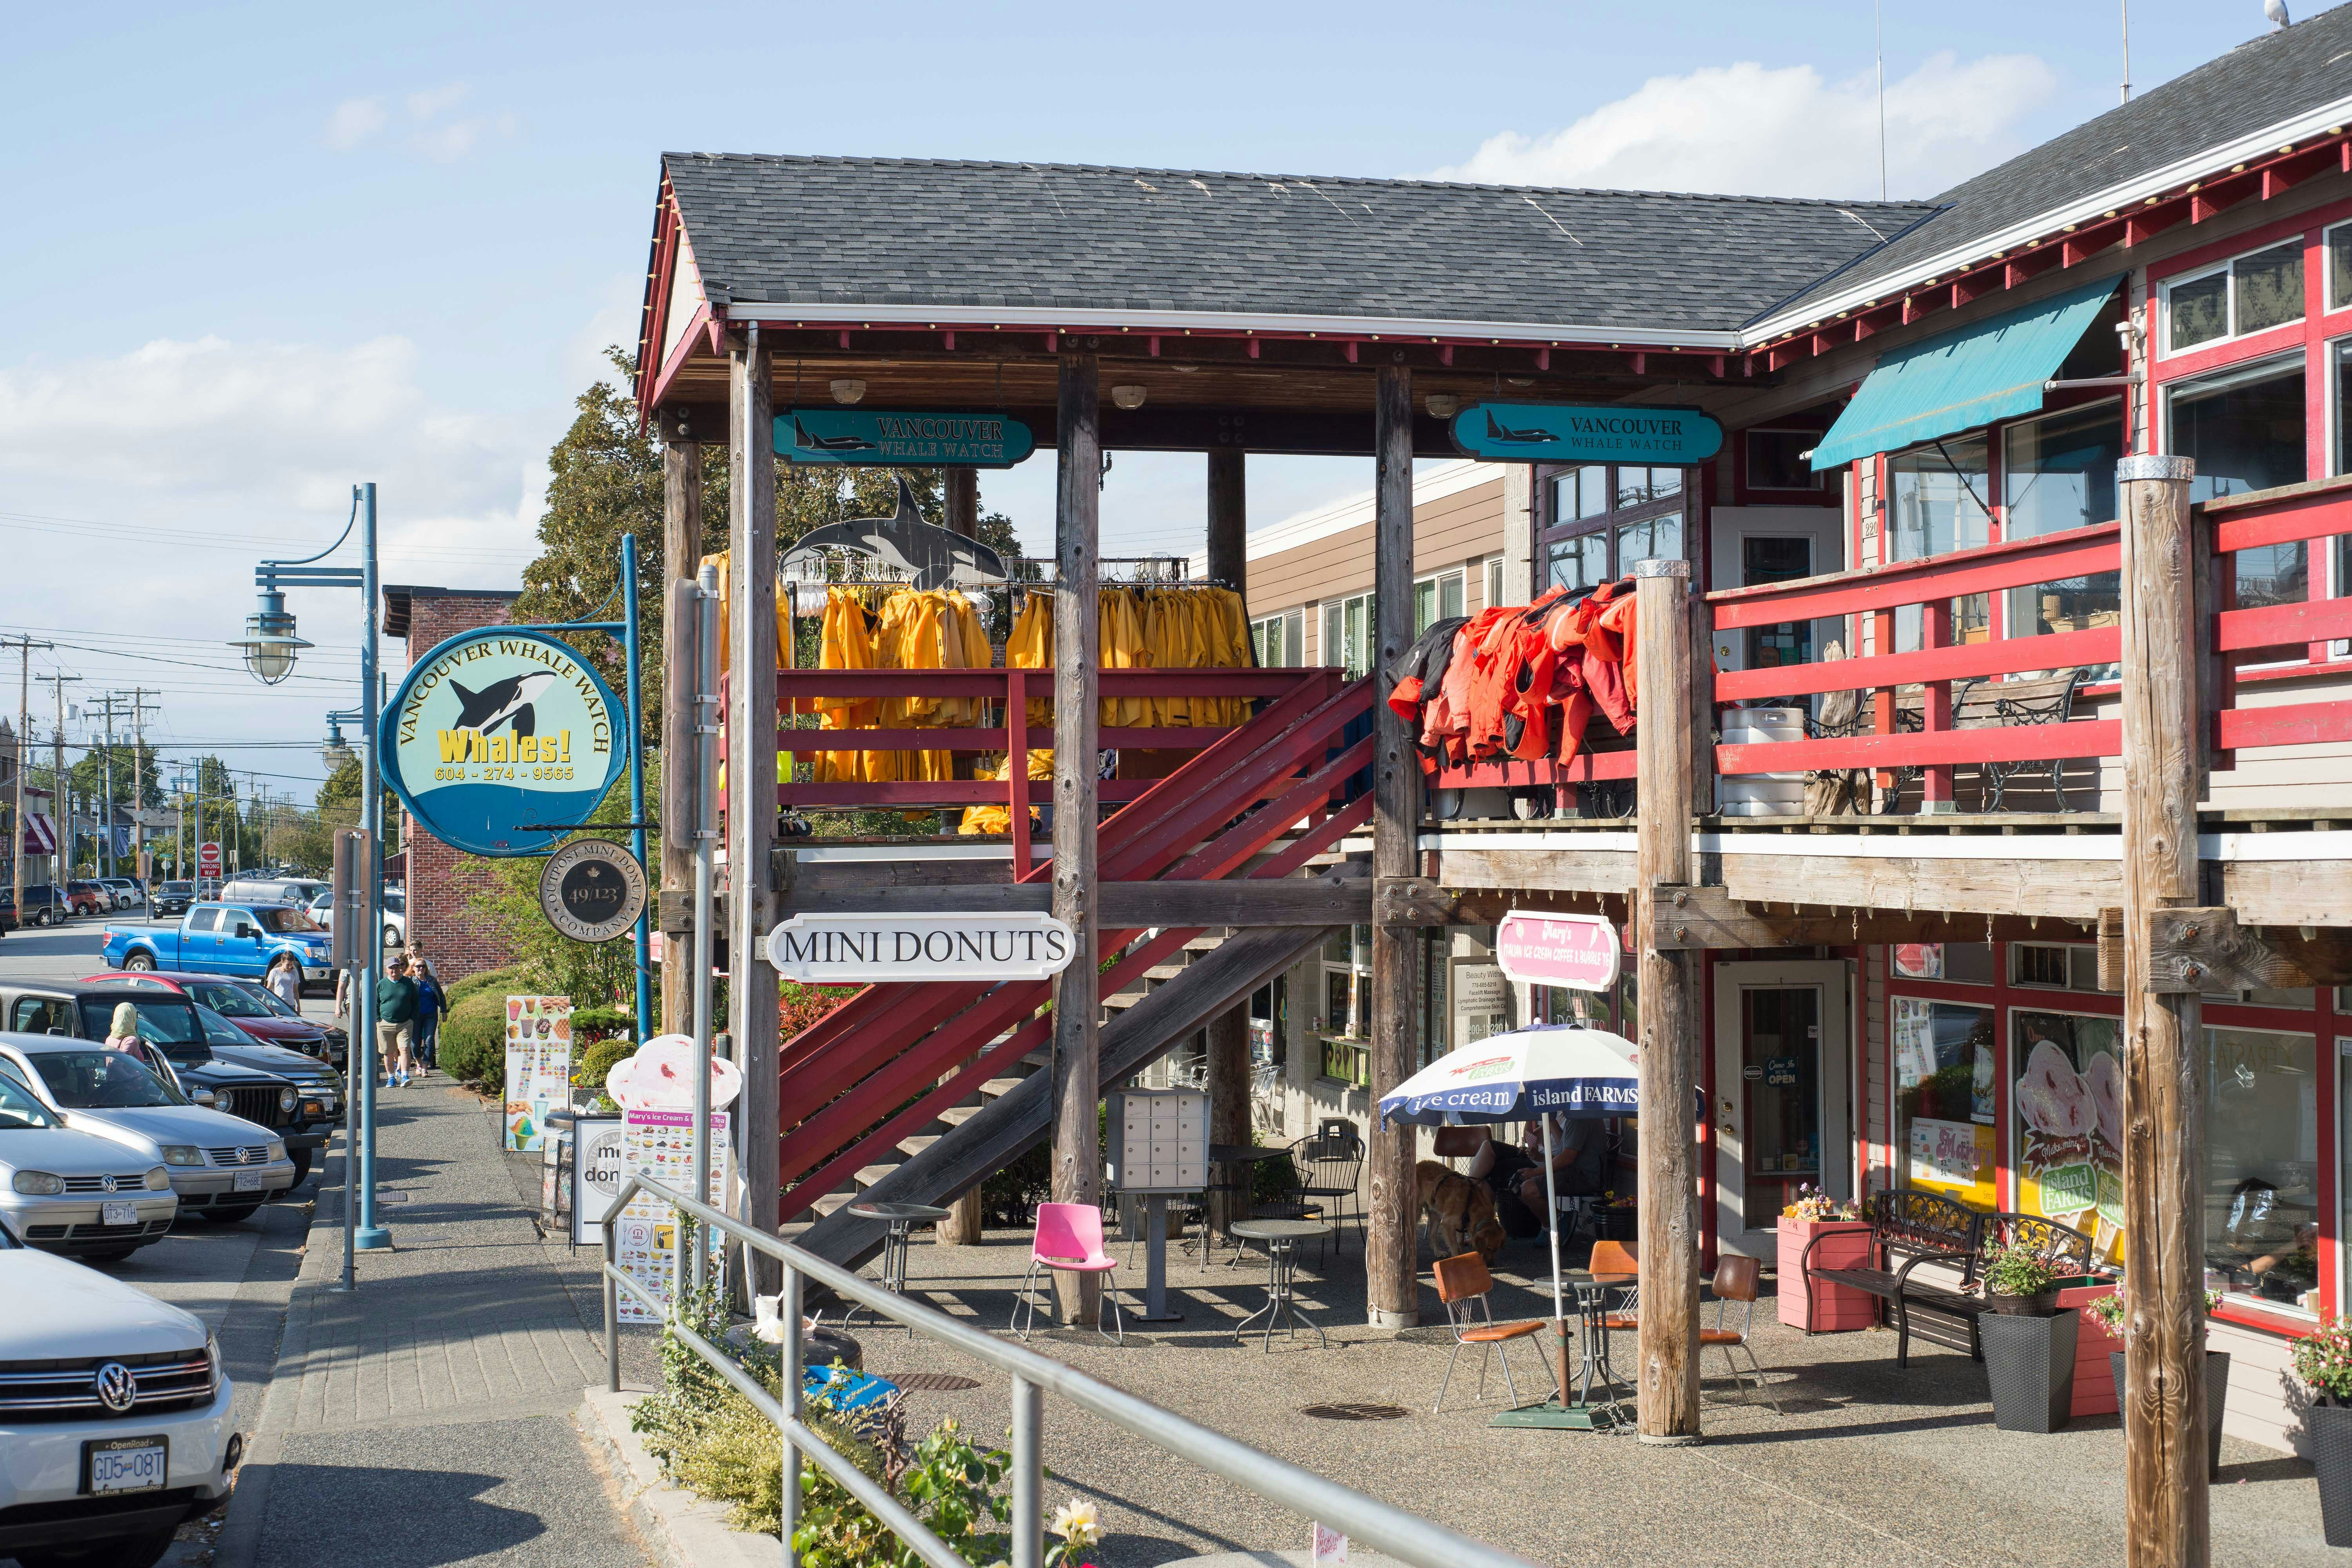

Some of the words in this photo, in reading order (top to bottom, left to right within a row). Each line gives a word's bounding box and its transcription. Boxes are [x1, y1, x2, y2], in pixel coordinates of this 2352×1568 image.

[877, 417, 1004, 441] VANCOUVER
[1570, 417, 1683, 436] VANCOUVER
[879, 441, 937, 456] WHALE
[943, 443, 1003, 458] WATCH
[1571, 437, 1623, 449] WHALE
[1630, 439, 1682, 450] WATCH
[400, 642, 493, 746] VANCOUVER
[498, 641, 576, 679] WHALE
[575, 675, 608, 753] WATCH
[437, 729, 571, 763] Whales!
[435, 767, 465, 780] 604
[484, 767, 514, 780] 274
[533, 766, 573, 780] 9565
[547, 848, 579, 903] OUTPOST
[584, 845, 615, 857] MINI
[619, 855, 641, 903] DONUT
[559, 913, 630, 936] COMPANY
[1542, 920, 1572, 944] Mary's
[782, 931, 882, 962] MINI
[892, 930, 1065, 962] DONUTS
[1504, 944, 1523, 958] ITALIAN
[1524, 945, 1532, 958] ICE
[1534, 946, 1552, 960] CREAM
[1553, 947, 1573, 963] COFFEE
[1575, 950, 1579, 963] &
[1580, 950, 1601, 965] BUBBLE
[1466, 971, 1486, 980] Beauty
[1769, 1060, 1784, 1070] Come
[1769, 1074, 1795, 1084] OPEN
[1448, 1091, 1510, 1105] cream
[1533, 1086, 1582, 1106] island
[1584, 1087, 1638, 1103] FARMS
[629, 1112, 651, 1121] Mary's
[1936, 1129, 1993, 1170] Mary's
[2042, 1143, 2062, 1160] Make
[2098, 1146, 2111, 1158] Make
[2046, 1167, 2089, 1192] island
[2045, 1186, 2092, 1210] FARMS
[111, 1439, 149, 1450] OpenRoad
[123, 1485, 161, 1493] RICHMOND
[1316, 1531, 1342, 1549] SMOKING
[1317, 1524, 1324, 1539] NO
[1320, 1544, 1337, 1557] AREA
